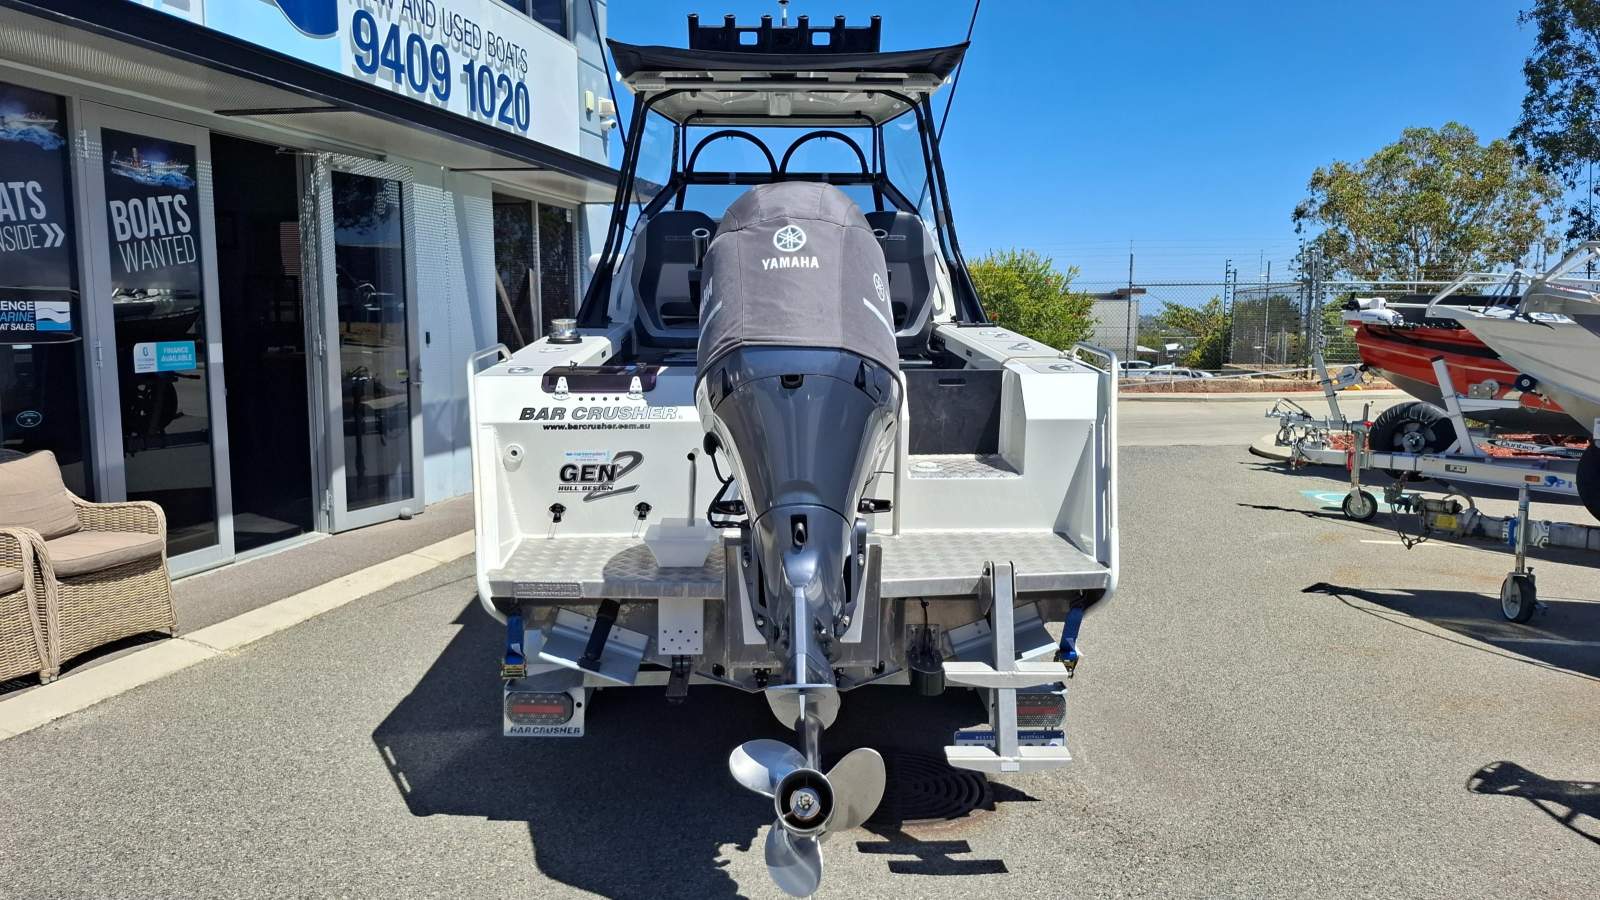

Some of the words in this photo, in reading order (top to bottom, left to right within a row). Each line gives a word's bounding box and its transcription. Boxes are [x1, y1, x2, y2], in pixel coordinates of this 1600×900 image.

[401, 0, 436, 28] AND
[442, 8, 481, 51] USED
[487, 31, 528, 74] BOATS
[352, 9, 451, 102] 9409
[462, 59, 531, 132] 1020
[0, 181, 47, 221] ATS
[109, 194, 191, 241] BOATS
[118, 234, 197, 273] WANTED
[762, 256, 820, 270] YAMAHA
[10, 323, 35, 331] SALES
[519, 407, 567, 421] BAR
[571, 406, 679, 421] CRUSHER
[543, 422, 651, 430] www.barcrusher.com.au
[559, 463, 617, 483] GEN
